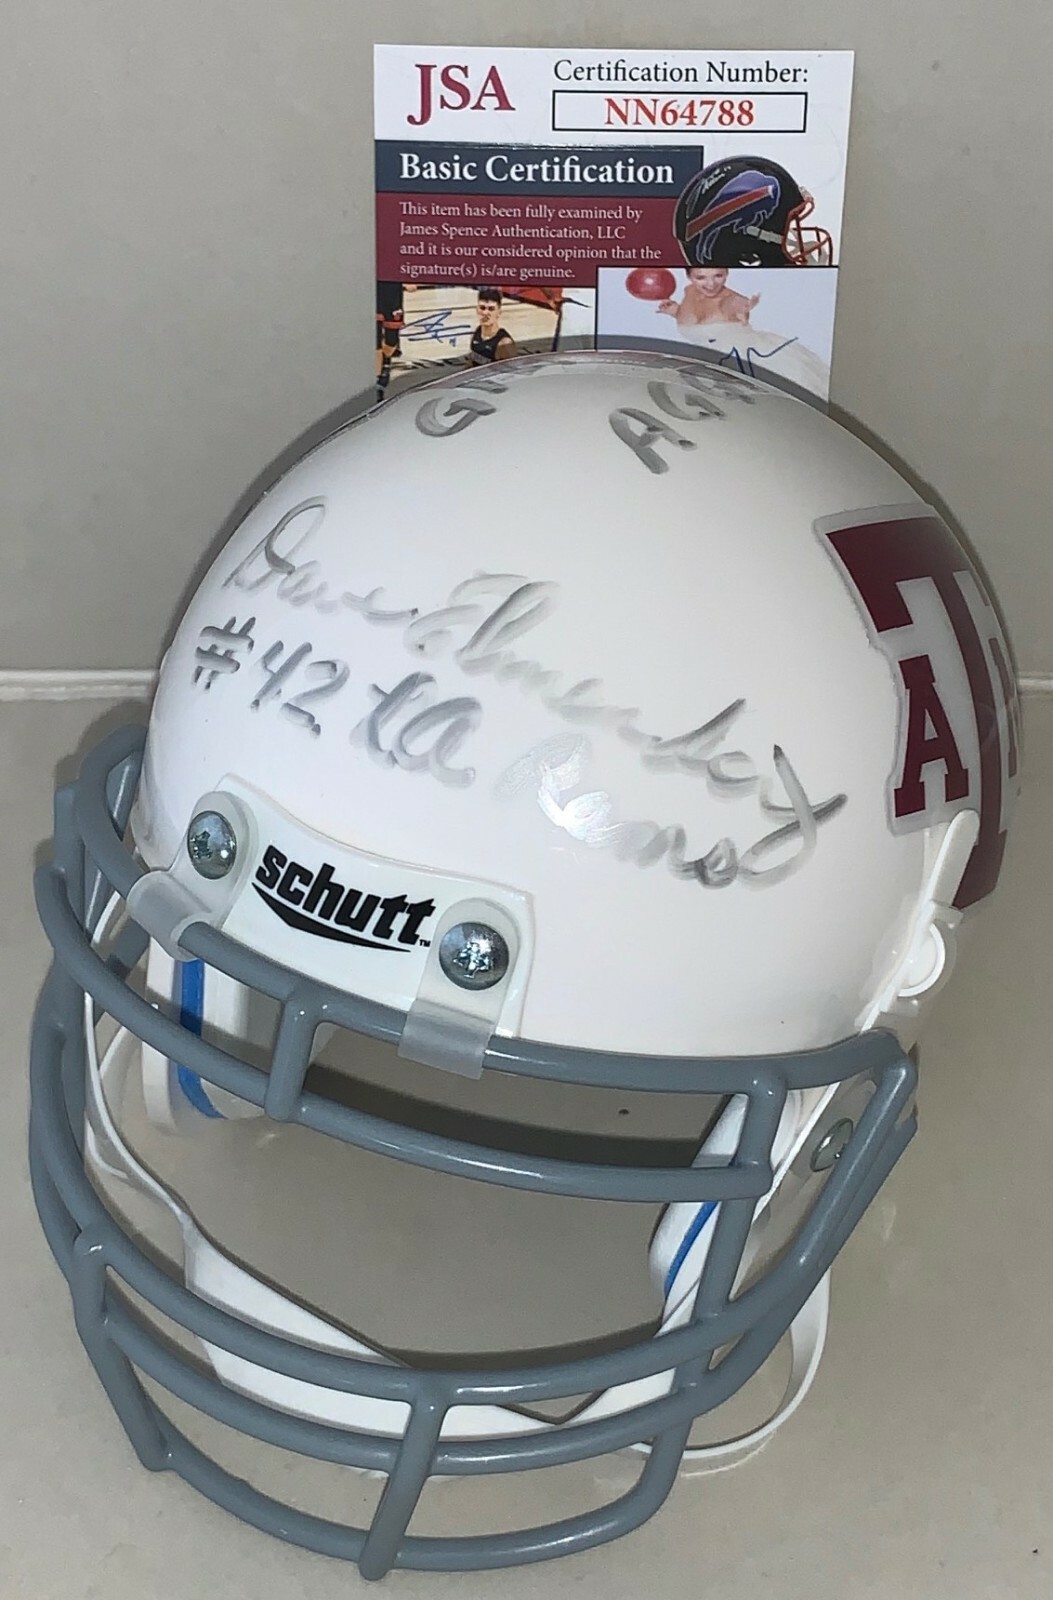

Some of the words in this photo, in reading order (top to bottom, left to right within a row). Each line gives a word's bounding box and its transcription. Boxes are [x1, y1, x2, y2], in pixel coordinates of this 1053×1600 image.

[553, 59, 699, 83] Certification
[705, 61, 809, 83] Number:
[406, 64, 516, 126] JSA
[604, 98, 755, 127] NN64788
[400, 152, 477, 182] Basic
[485, 154, 674, 184] Certification
[399, 202, 427, 216] This
[431, 203, 460, 216] item
[464, 204, 487, 217] has
[490, 204, 521, 218] been
[525, 204, 554, 222] fully
[558, 205, 623, 220] examined
[626, 206, 643, 223] by
[399, 222, 438, 237] James
[441, 223, 488, 240] Spence
[491, 224, 594, 240] Authentication,
[597, 226, 626, 239] LLC
[399, 242, 424, 256] and
[428, 243, 438, 256] it
[441, 243, 452, 256] is
[454, 246, 479, 257] our
[481, 244, 552, 258] considered
[555, 247, 608, 262] opinion
[611, 246, 637, 259] that
[640, 247, 662, 260] the
[399, 262, 478, 279] signature(s)
[480, 263, 516, 277] is/are
[519, 265, 576, 281] genuine.
[255, 844, 436, 945] schutt
